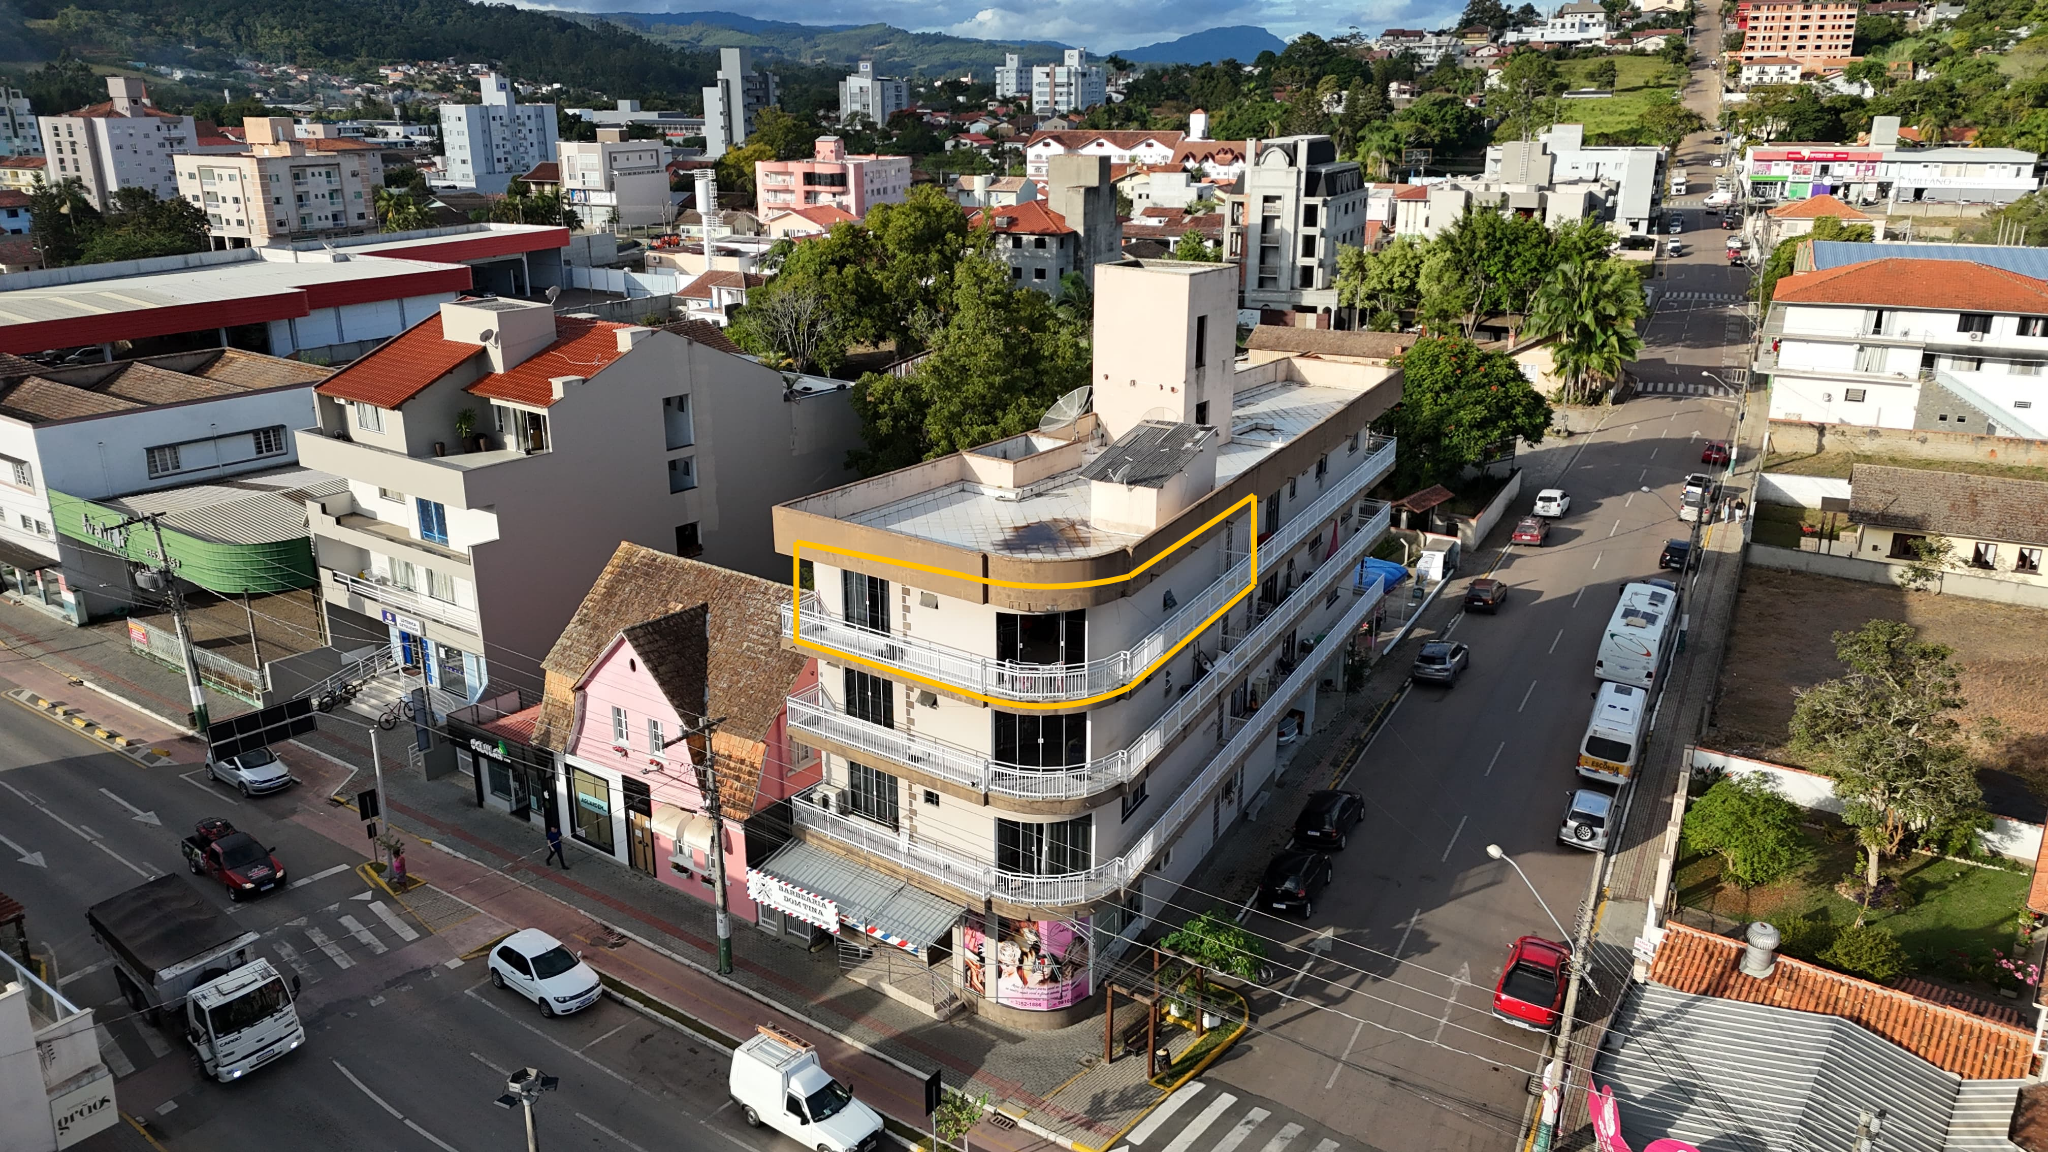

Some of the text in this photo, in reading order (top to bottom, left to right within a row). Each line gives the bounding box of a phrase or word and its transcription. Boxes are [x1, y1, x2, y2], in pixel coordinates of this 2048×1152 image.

[1591, 760, 1620, 774] ESCOLAR
[778, 884, 828, 910] BARBEARIA
[783, 895, 802, 909] DOM
[802, 903, 825, 918] TINA
[219, 1035, 242, 1048] CARGO
